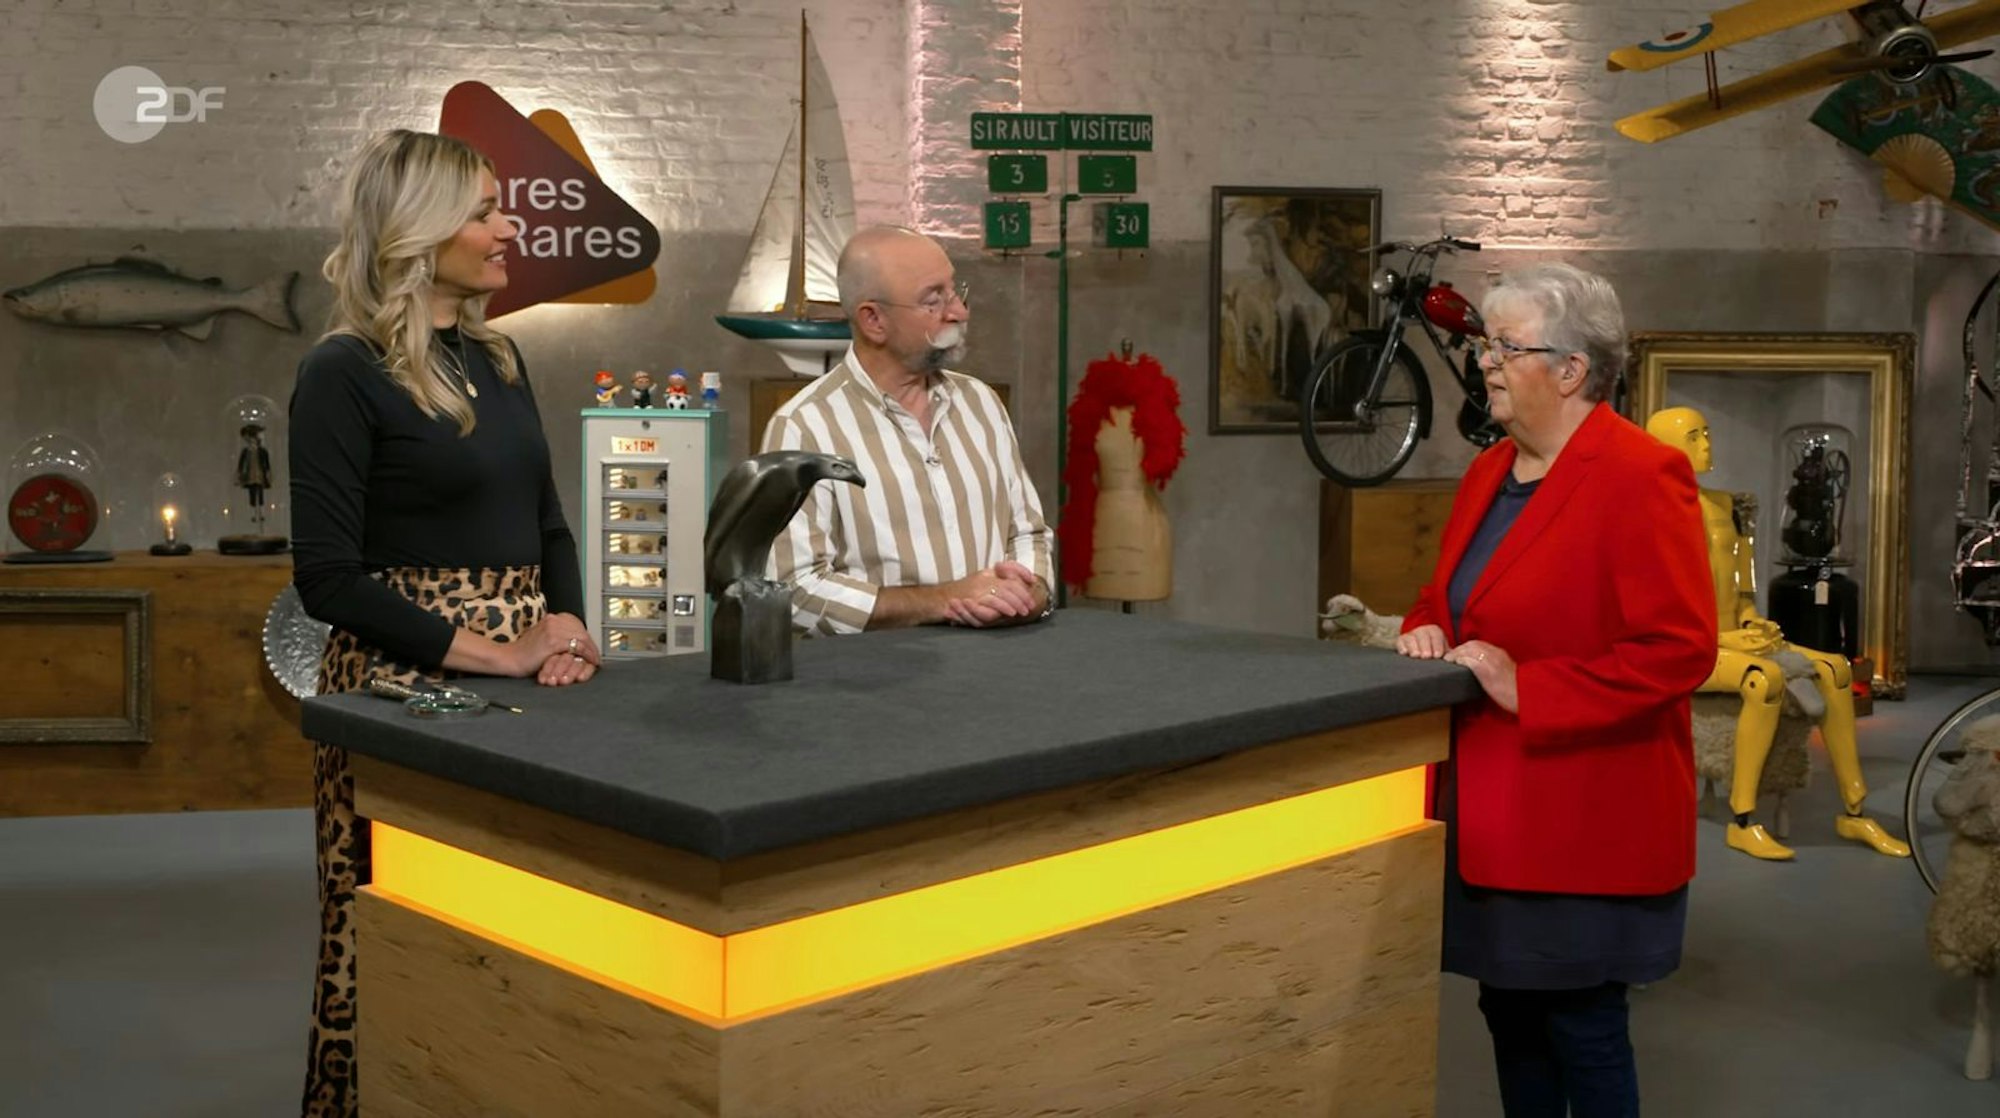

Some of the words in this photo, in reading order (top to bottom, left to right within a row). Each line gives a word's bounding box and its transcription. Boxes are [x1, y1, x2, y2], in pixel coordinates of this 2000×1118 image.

[973, 119, 1058, 141] SIRAULT
[1010, 163, 1025, 185] 3
[495, 177, 587, 211] res
[997, 212, 1021, 234] 15
[1115, 214, 1139, 235] 30
